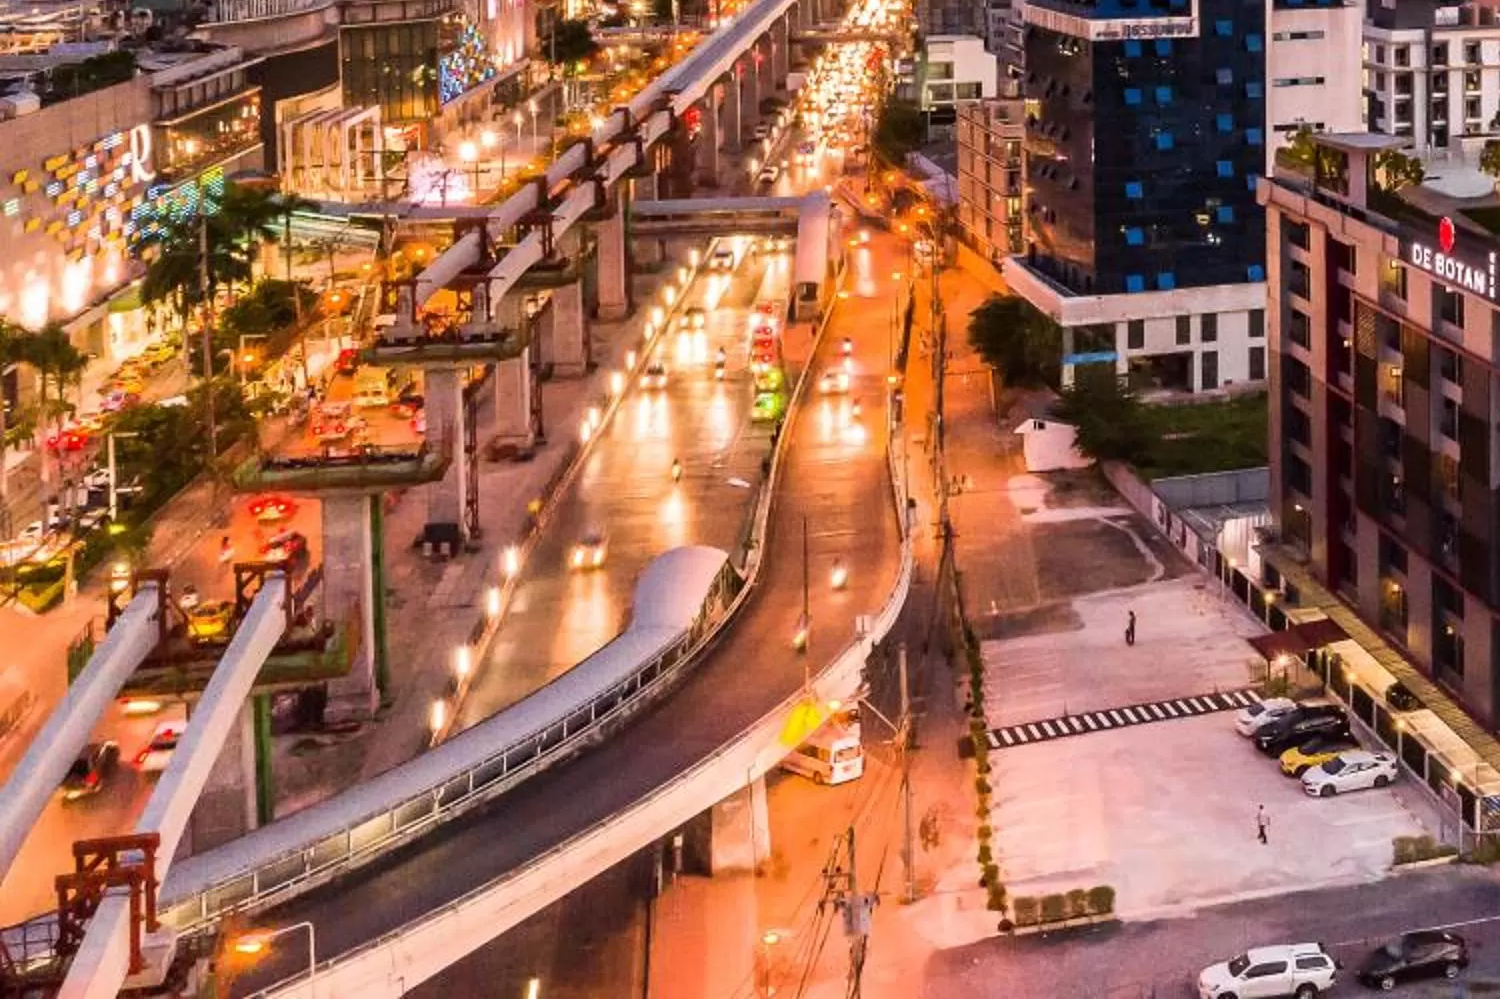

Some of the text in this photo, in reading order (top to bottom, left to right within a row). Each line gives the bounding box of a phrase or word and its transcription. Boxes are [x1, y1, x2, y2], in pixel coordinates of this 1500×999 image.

[130, 123, 156, 183] R
[1412, 242, 1433, 270] DE
[1435, 252, 1485, 294] BOTAN
